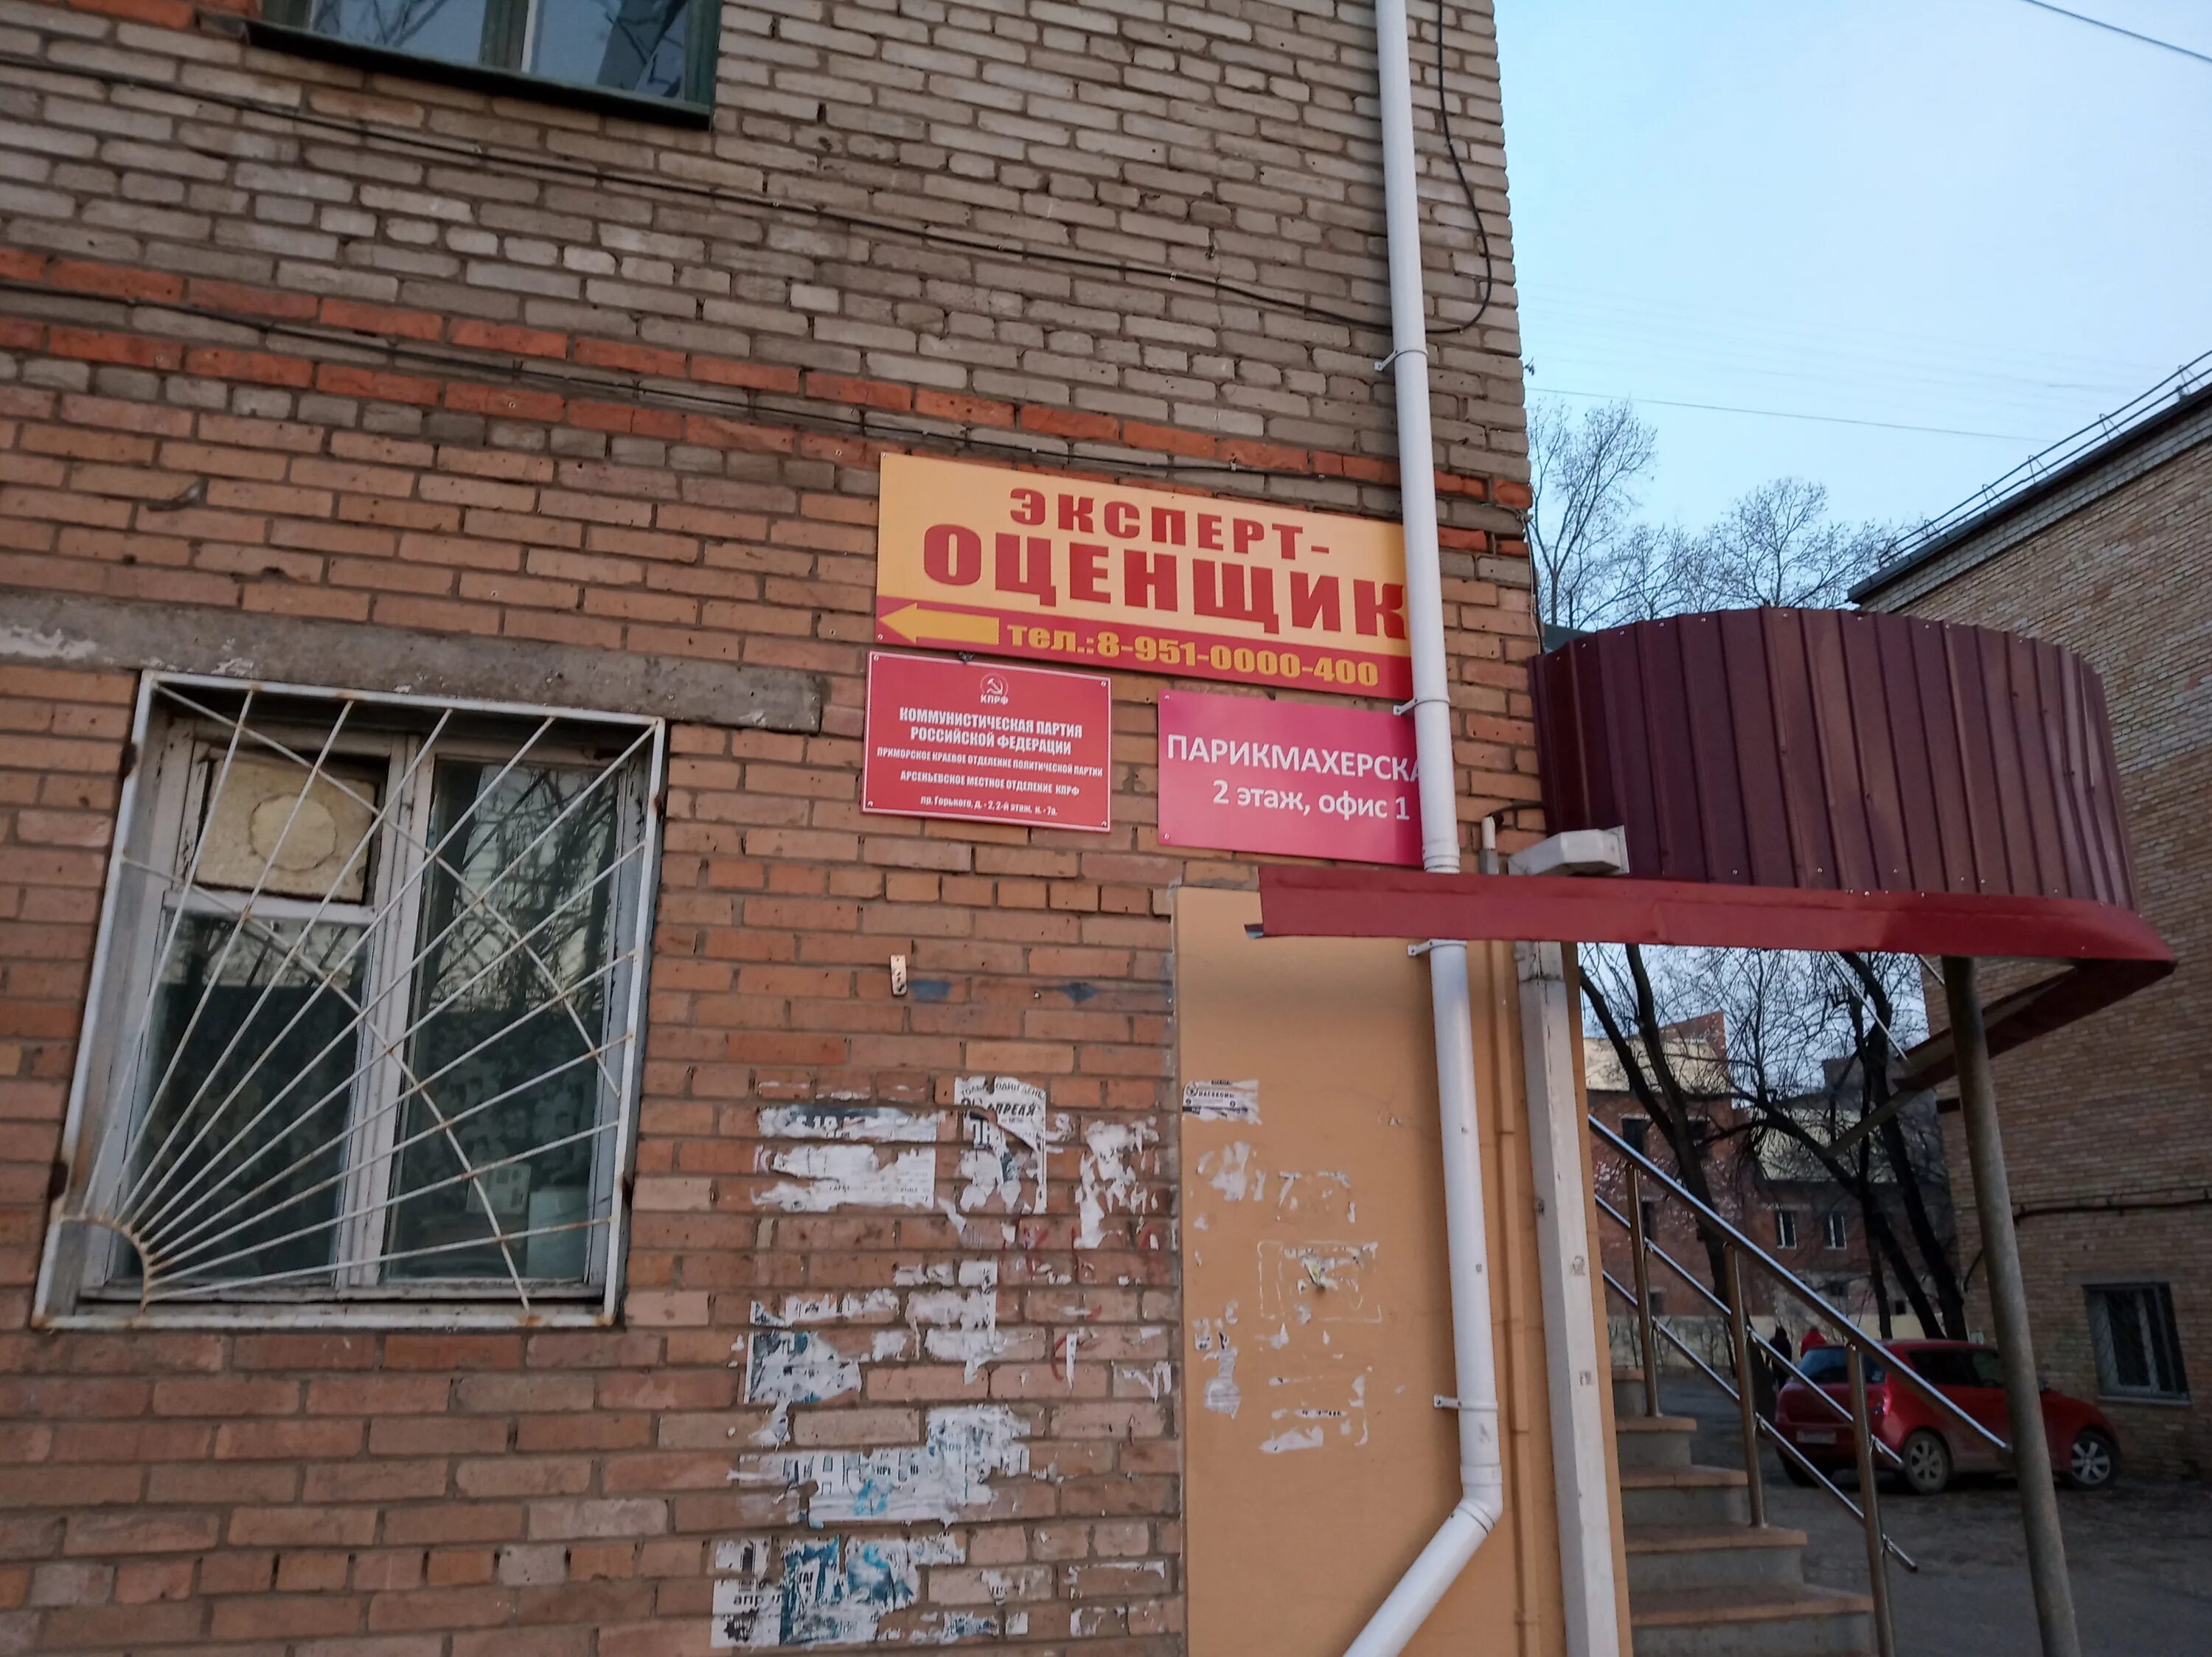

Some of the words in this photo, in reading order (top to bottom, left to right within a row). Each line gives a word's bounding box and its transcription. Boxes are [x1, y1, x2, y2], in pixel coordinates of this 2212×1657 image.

[1009, 487, 1330, 561] ЭКСПЕРТ-
[922, 523, 1408, 640] ОЦЕНЩИК
[980, 694, 1009, 705] КПРФ
[899, 706, 1034, 733] КОММУНИСТИЧЕСКАЯ
[1035, 720, 1082, 739] ПАРТИЯ
[910, 726, 995, 748] РОССИЙСКОЙ
[997, 734, 1072, 756] ФЕДЕРАЦИИ
[877, 746, 931, 762] ПРИМОРСКОЕ
[932, 751, 967, 764] КРАЕВОЕ
[967, 756, 1012, 769] ОТДЕЛЕНИЕ
[1012, 759, 1073, 775] ПОЛИТИЧЕСКОЙ
[1074, 765, 1103, 778] ПАРТИИ
[900, 770, 966, 787] АРСЕНЬЕВСКОЕ
[966, 775, 1006, 788] МЕСТНОЕ
[1006, 779, 1054, 794] ОТДЕЛЕНИЕ
[1055, 784, 1080, 796] КПРФ
[1212, 779, 1229, 805] 2
[1237, 785, 1311, 816] этаж,
[1318, 791, 1388, 821] офис
[1394, 796, 1411, 821] 1
